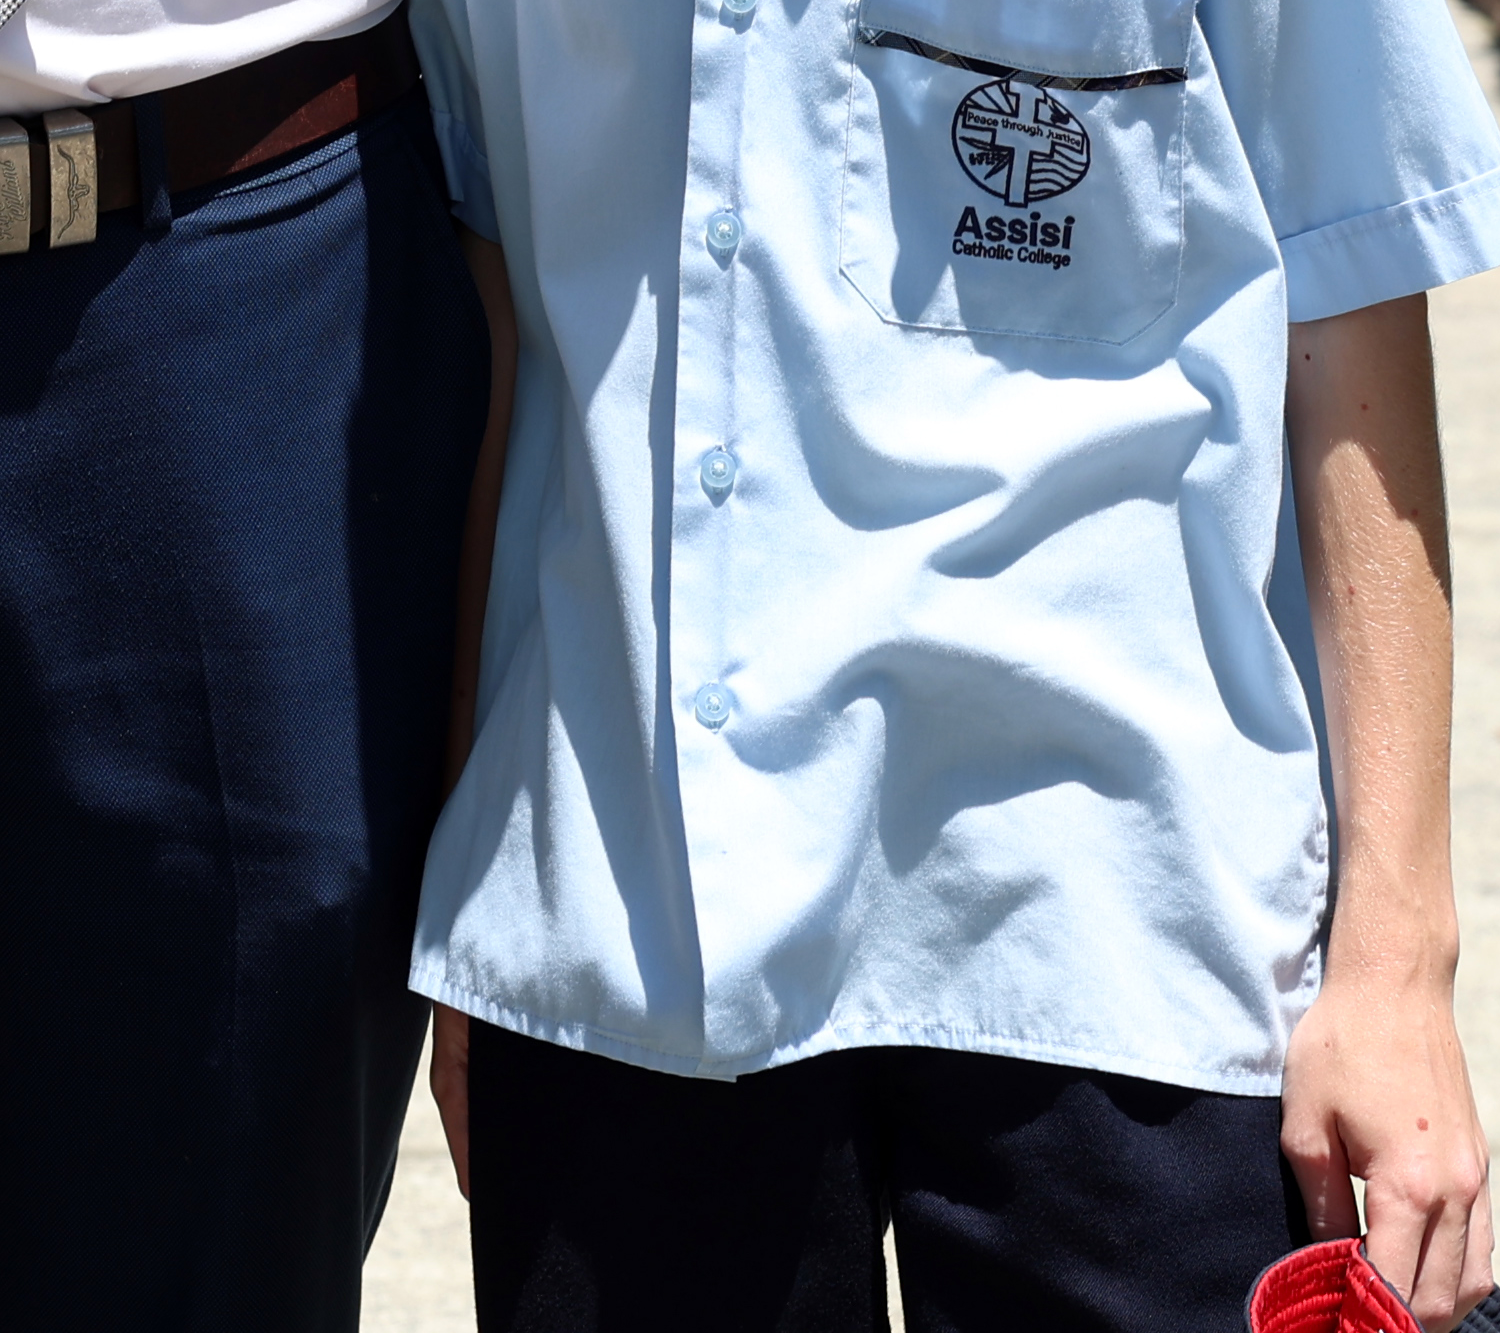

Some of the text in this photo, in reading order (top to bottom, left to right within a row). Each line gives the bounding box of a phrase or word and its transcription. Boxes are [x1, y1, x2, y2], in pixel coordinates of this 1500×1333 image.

[967, 111, 1081, 147] Peace through Justice
[953, 205, 1076, 250] Assisi
[952, 238, 1071, 271] Catholic College
